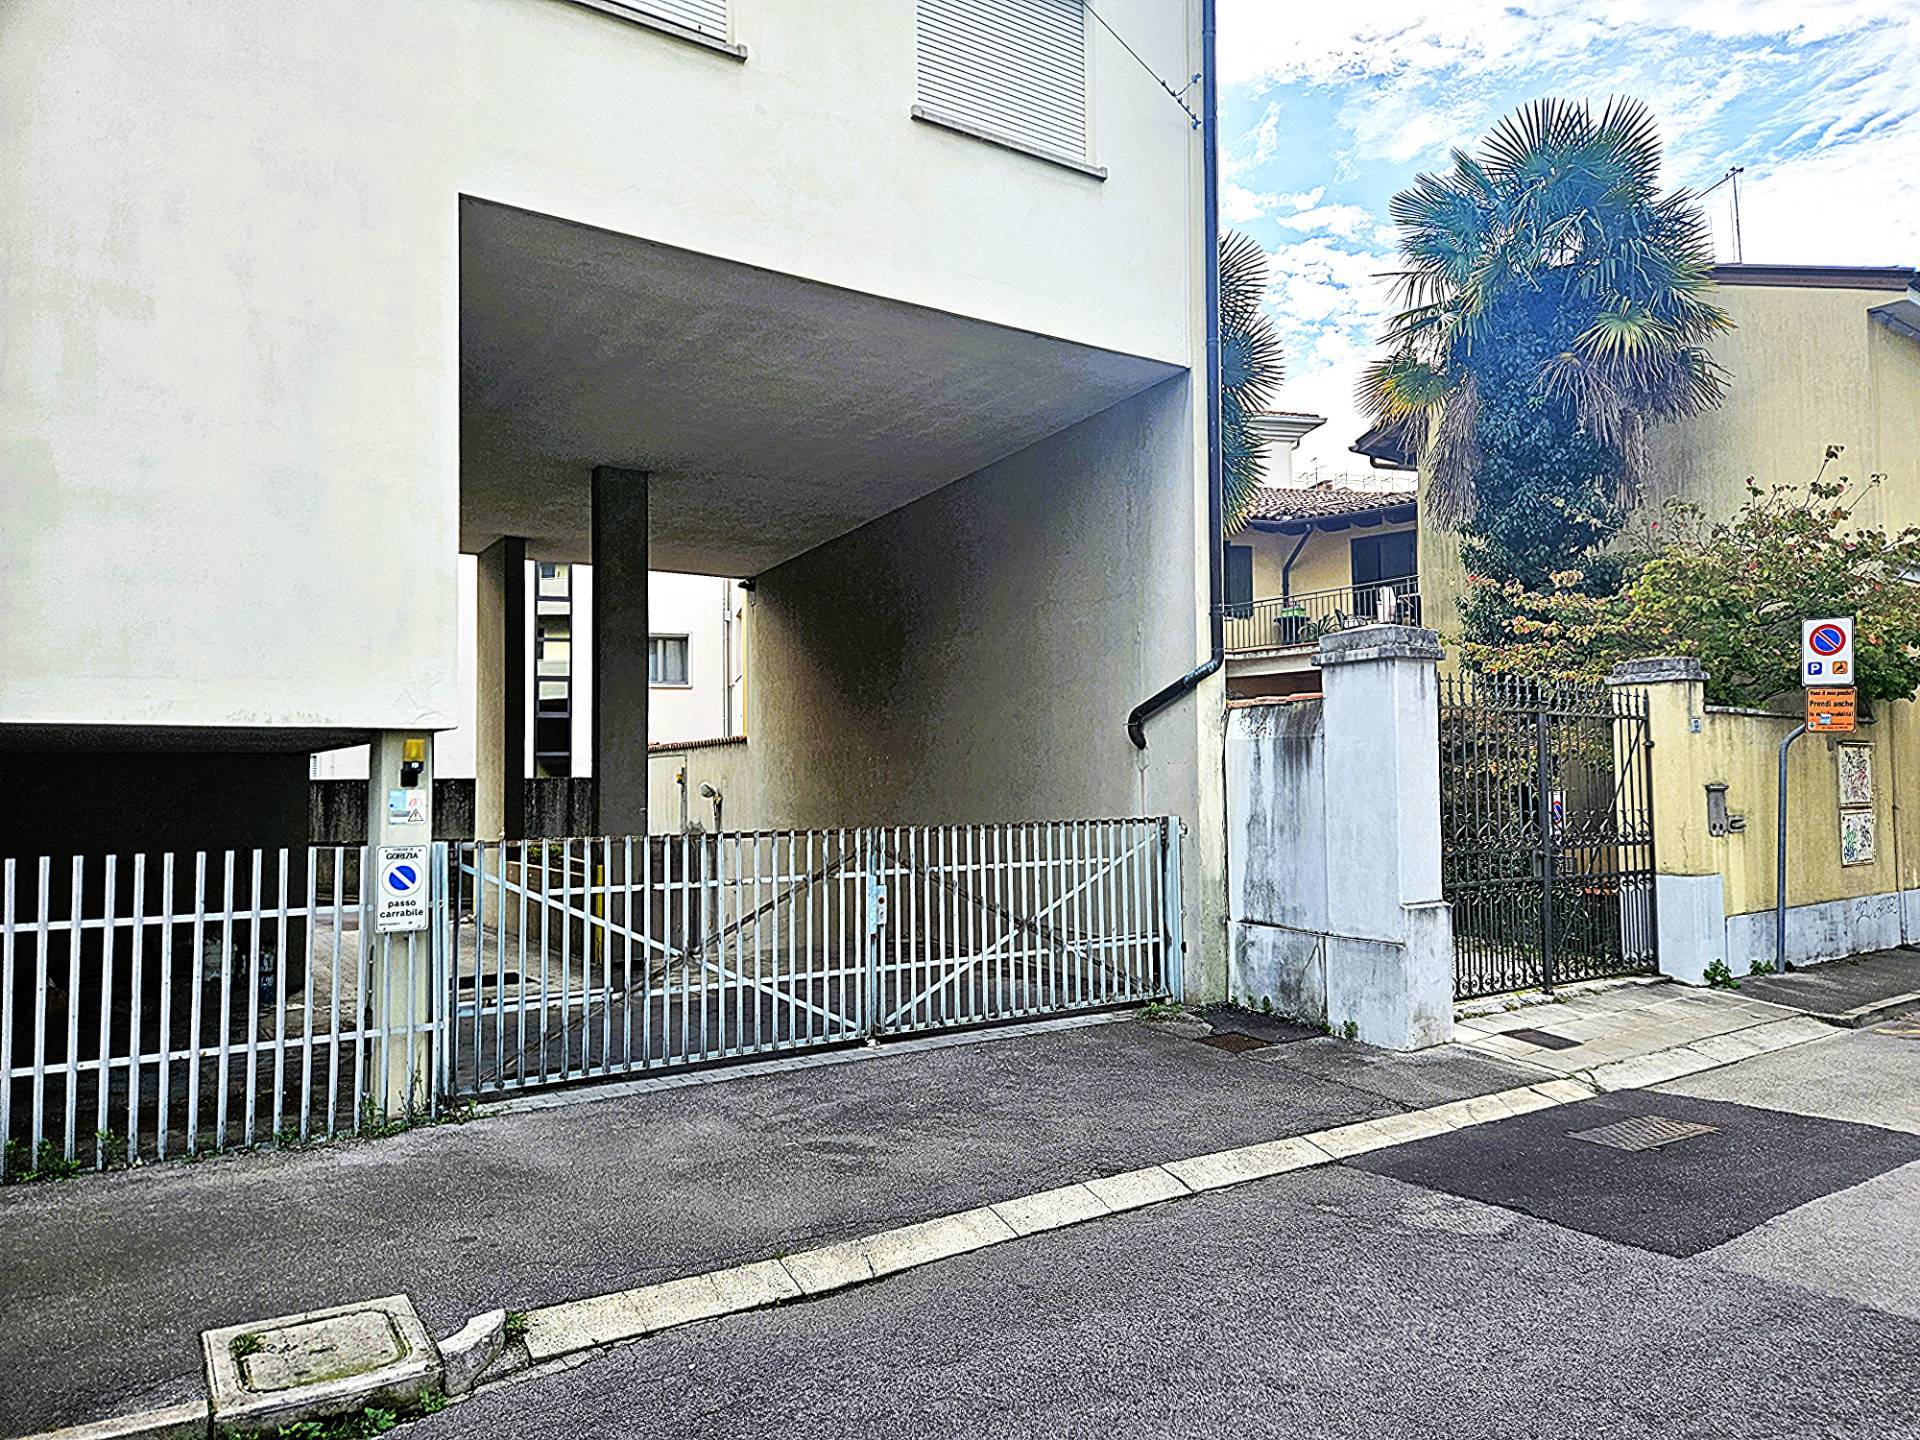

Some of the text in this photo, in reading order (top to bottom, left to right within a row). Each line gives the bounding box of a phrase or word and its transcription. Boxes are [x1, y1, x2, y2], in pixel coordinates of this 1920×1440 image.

[1811, 664, 1820, 674] P
[386, 852, 418, 860] GORIZIA
[388, 900, 416, 908] passo
[380, 909, 424, 918] carrabile
